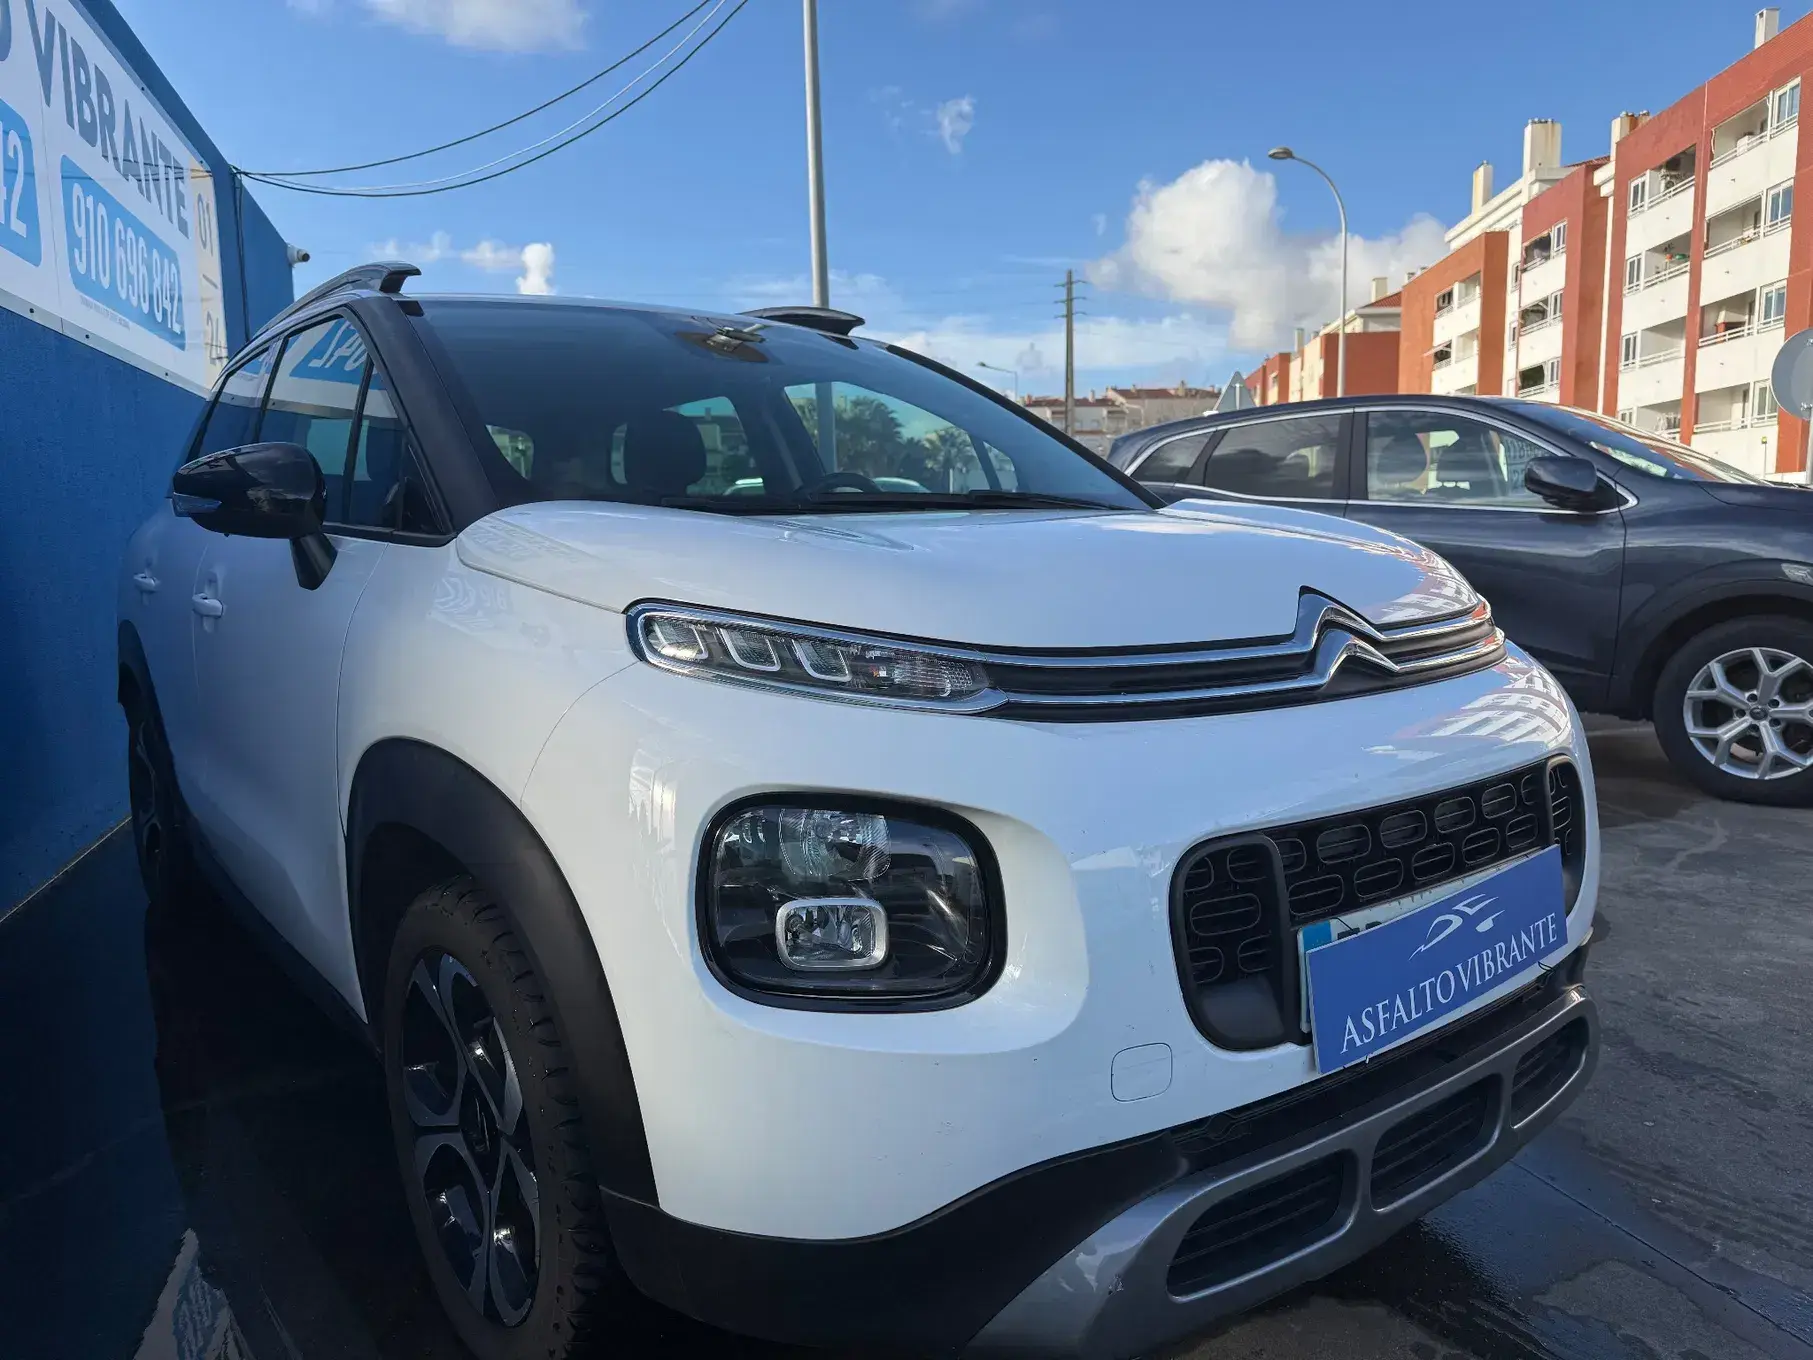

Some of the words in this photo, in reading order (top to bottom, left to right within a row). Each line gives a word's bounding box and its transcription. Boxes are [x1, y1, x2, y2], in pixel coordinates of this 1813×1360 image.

[24, 0, 190, 240] VIBRANTE
[72, 183, 111, 289] 910
[115, 217, 149, 315] 696
[153, 257, 182, 335] 842
